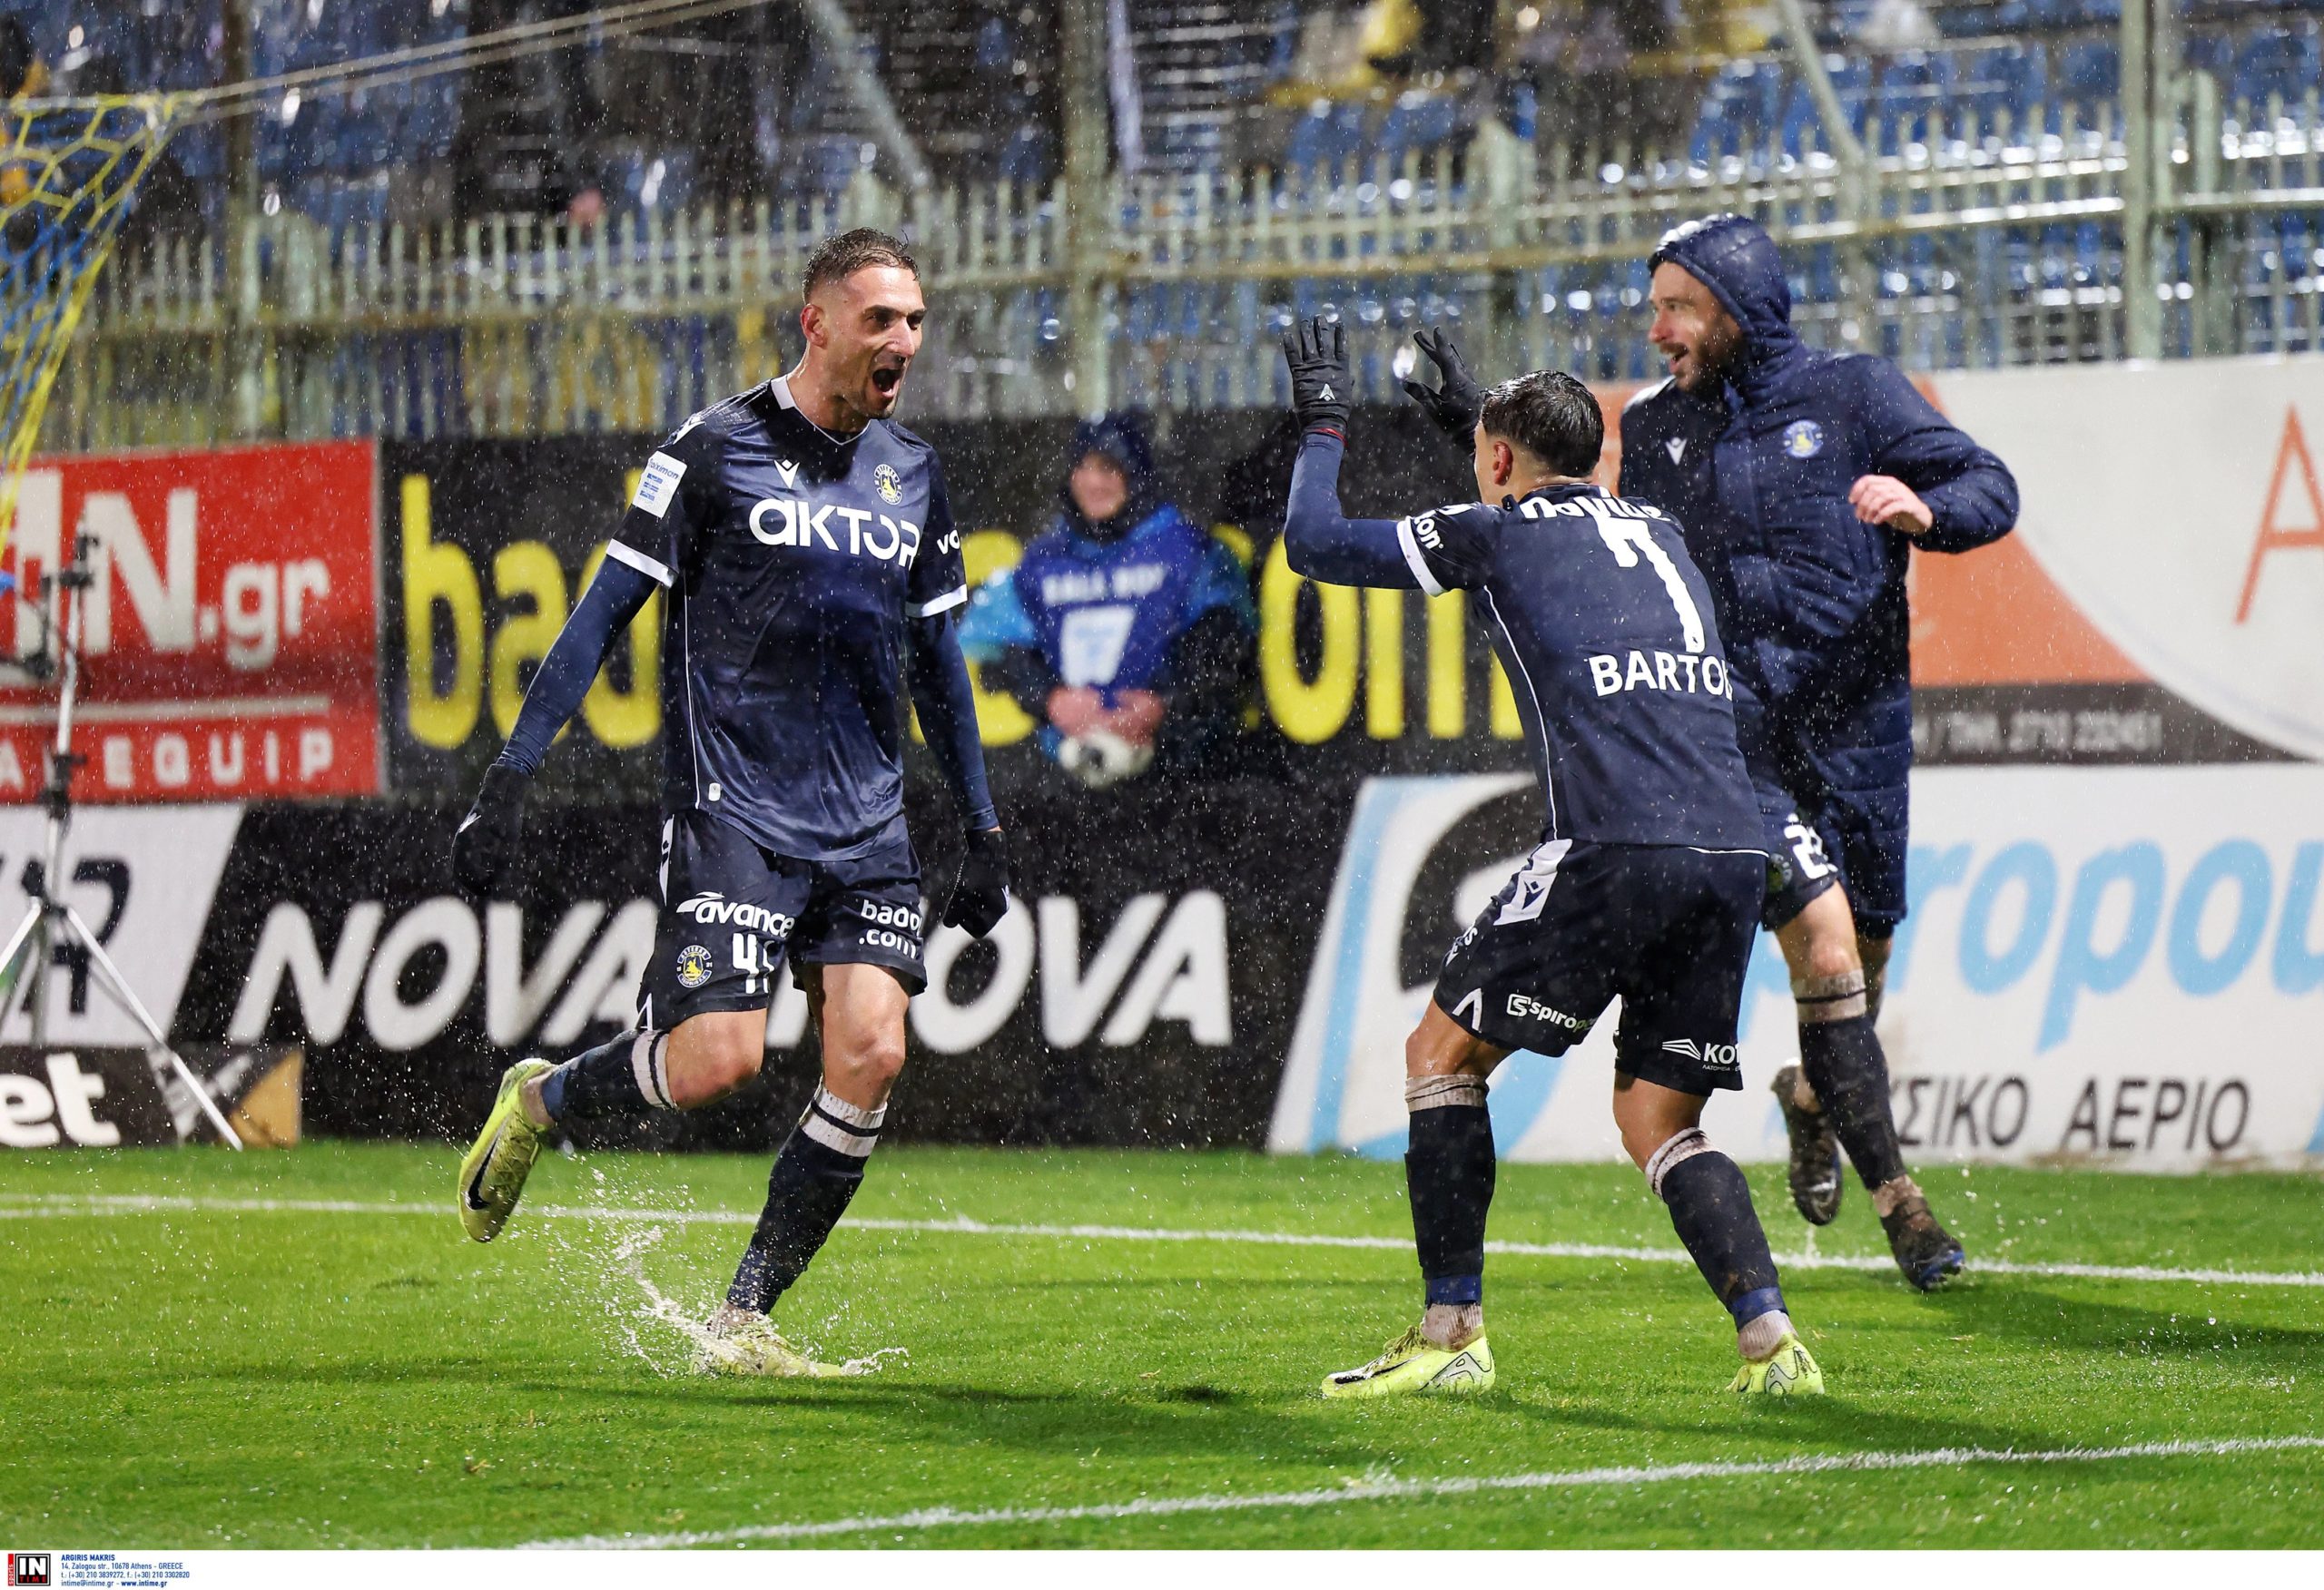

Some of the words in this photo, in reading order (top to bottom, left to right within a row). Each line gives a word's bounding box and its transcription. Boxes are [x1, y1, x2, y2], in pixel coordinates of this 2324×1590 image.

[1593, 515, 1705, 653] 7
[103, 727, 334, 791] EQUIP
[694, 900, 795, 937] avance
[859, 929, 917, 959] .com
[770, 889, 1232, 1055] OVA
[2059, 1075, 2252, 1152] ΑΕΡΙΟ
